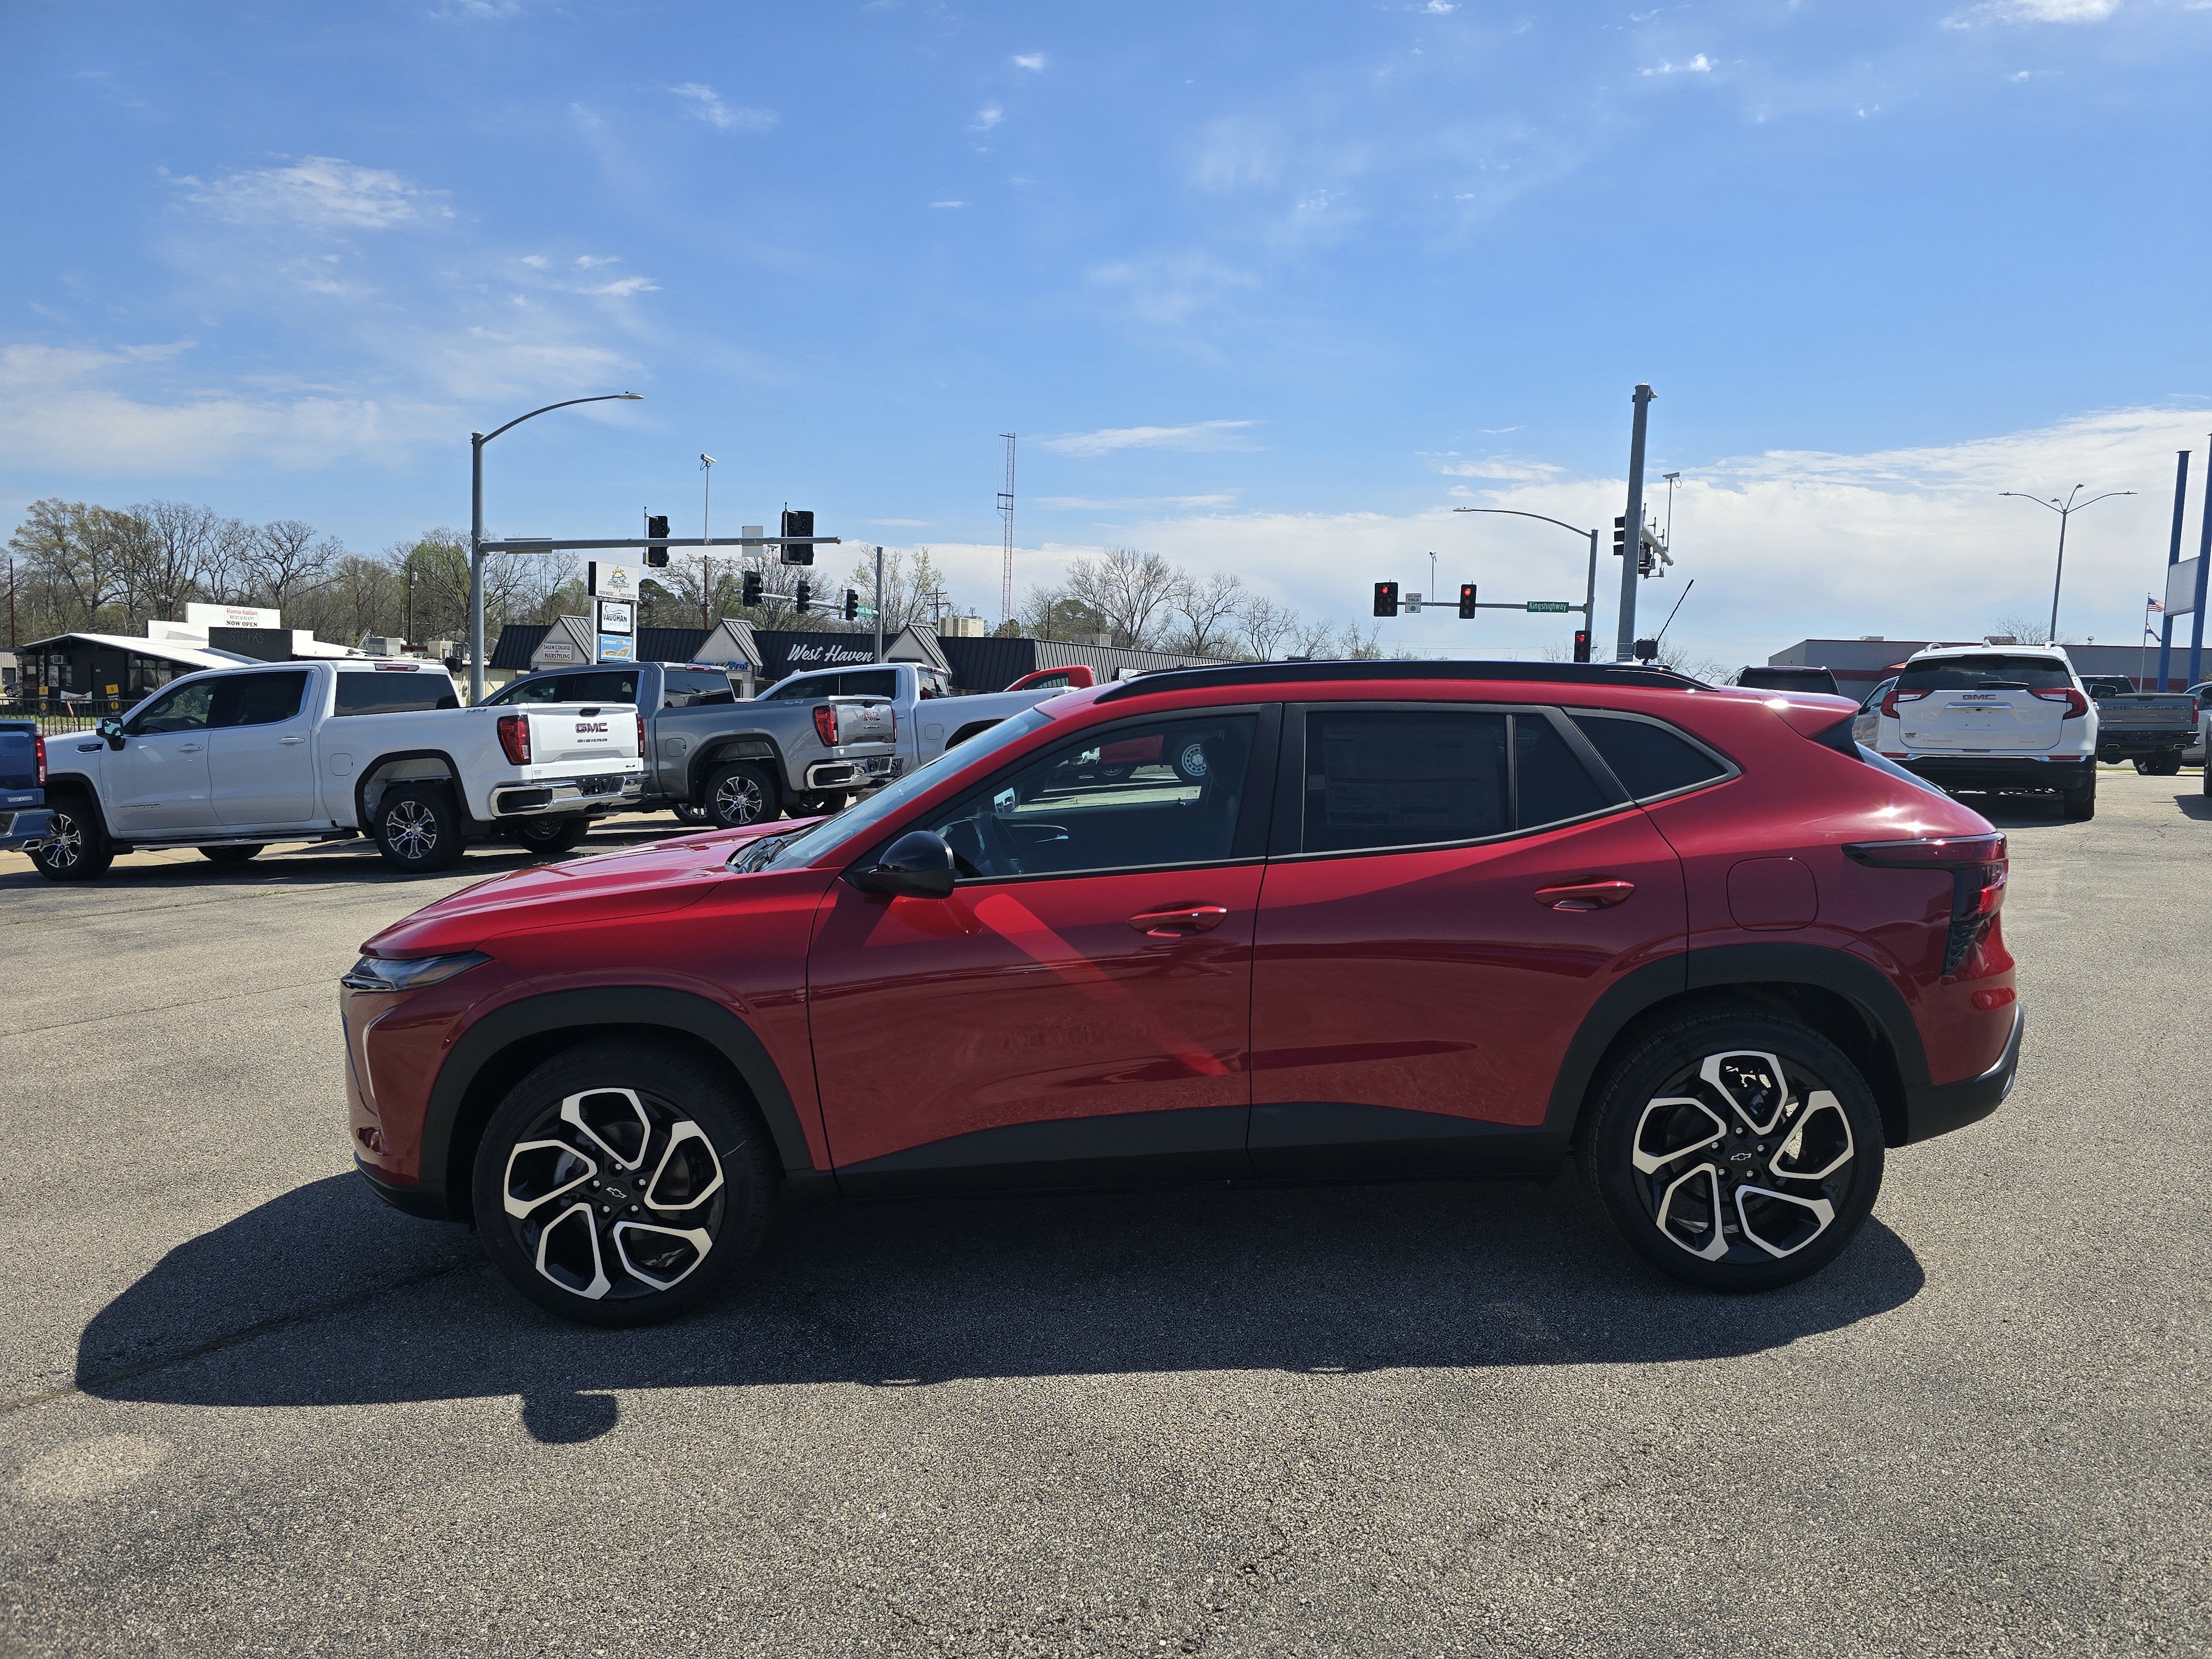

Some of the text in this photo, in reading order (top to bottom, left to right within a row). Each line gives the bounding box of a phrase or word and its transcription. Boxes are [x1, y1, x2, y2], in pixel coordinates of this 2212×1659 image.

[1529, 602, 1567, 612] Kingshighway
[603, 613, 627, 623] VAUGHAN
[787, 644, 874, 662] West Haven
[728, 661, 749, 670] Prof
[575, 722, 608, 733] GMC
